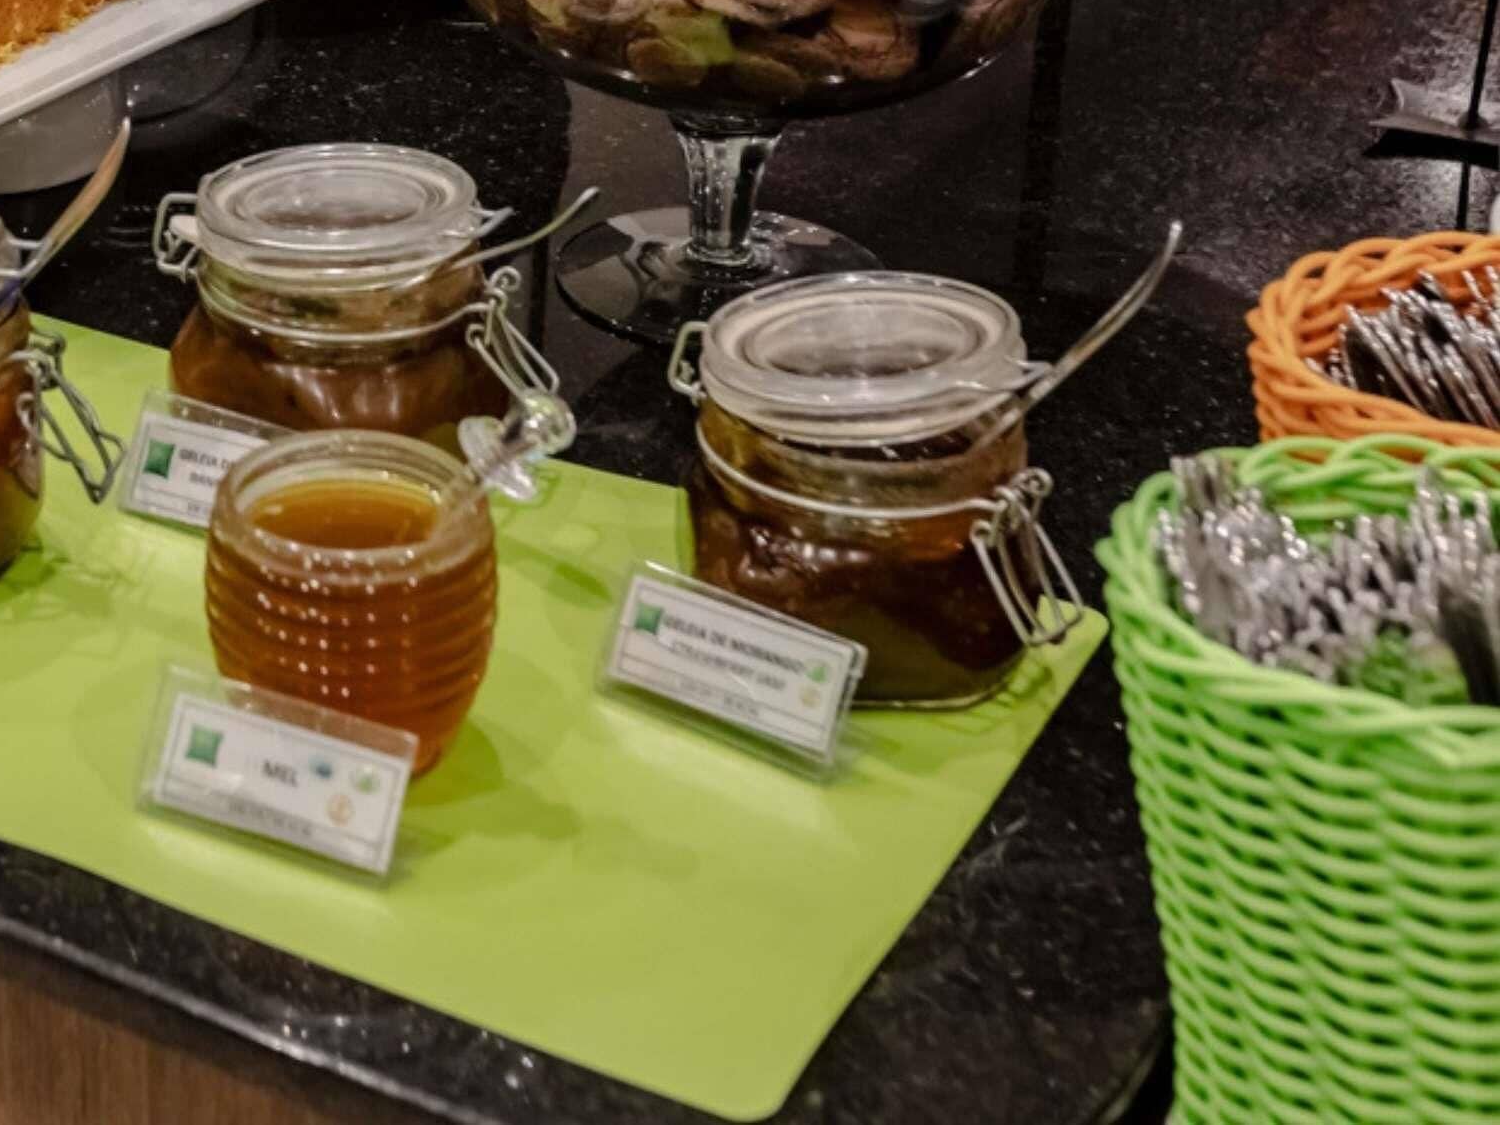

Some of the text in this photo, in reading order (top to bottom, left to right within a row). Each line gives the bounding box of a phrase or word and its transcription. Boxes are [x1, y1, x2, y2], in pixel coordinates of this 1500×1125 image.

[709, 630, 728, 648] DE
[730, 638, 805, 672] MORANGO
[261, 758, 298, 787] MEL
